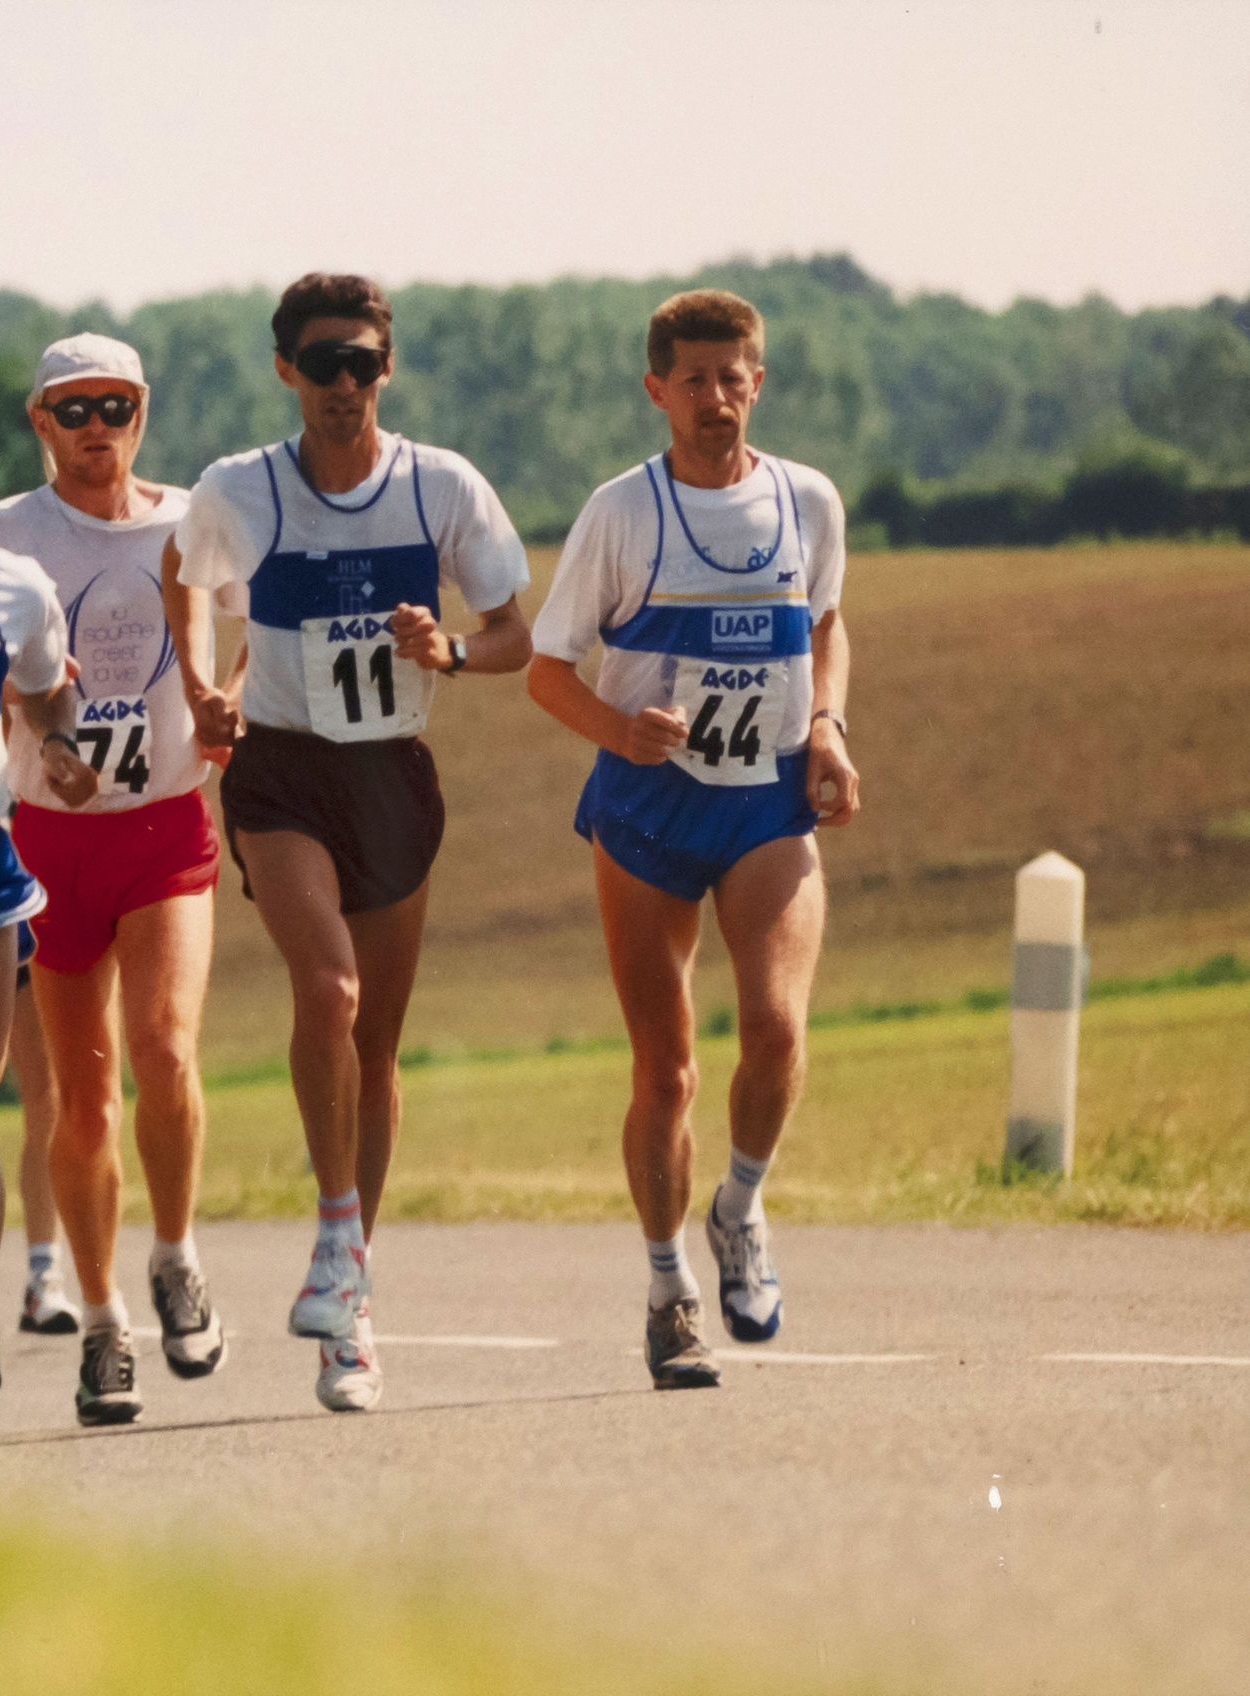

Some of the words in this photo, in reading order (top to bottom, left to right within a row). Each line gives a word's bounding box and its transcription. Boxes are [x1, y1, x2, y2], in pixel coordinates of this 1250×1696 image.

[714, 614, 770, 637] UAP
[333, 644, 395, 723] 11
[701, 667, 770, 690] AGDE
[83, 699, 147, 722] AGDE
[687, 694, 763, 767] 44
[76, 725, 149, 794] 74
